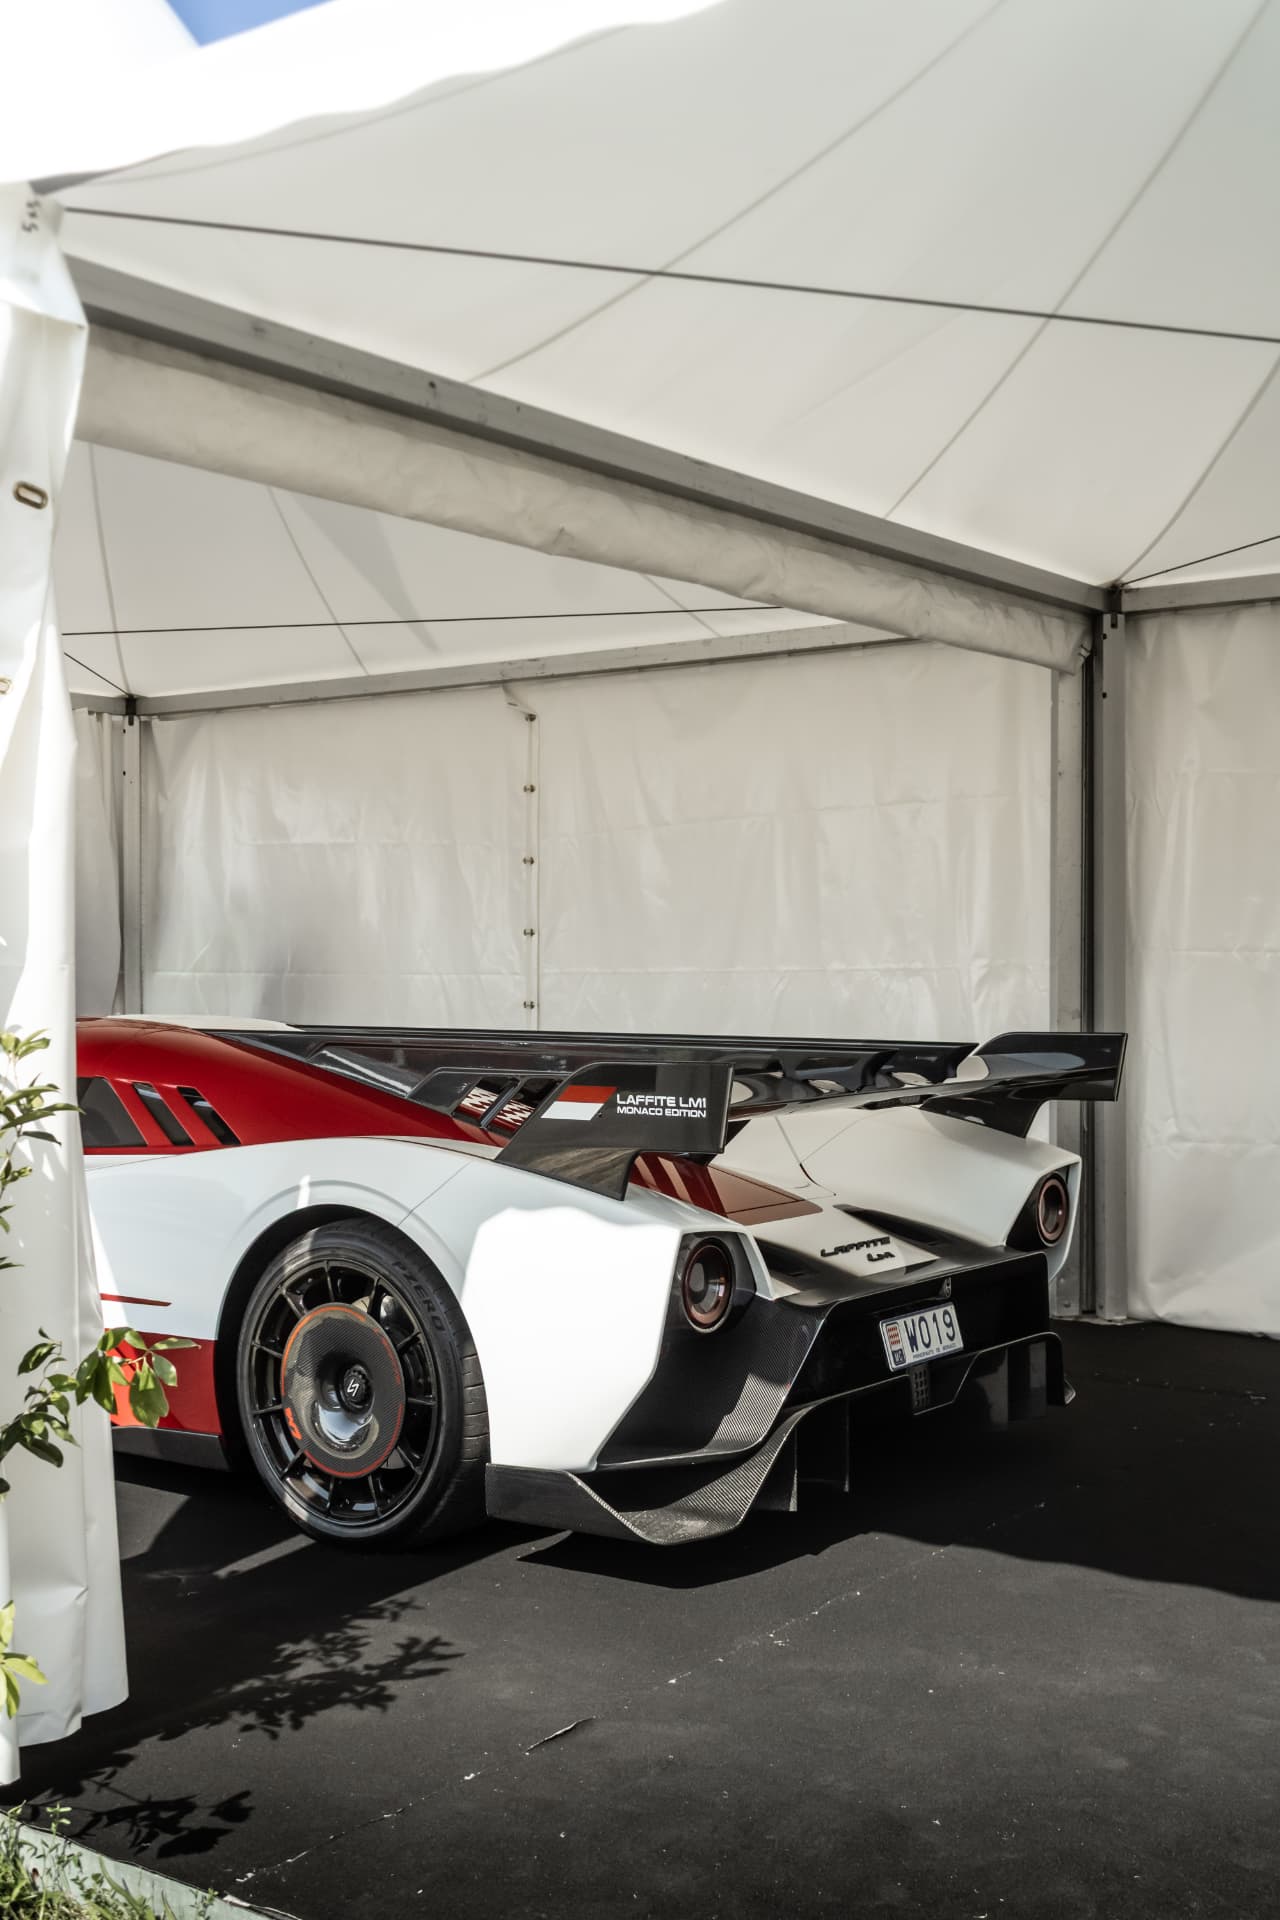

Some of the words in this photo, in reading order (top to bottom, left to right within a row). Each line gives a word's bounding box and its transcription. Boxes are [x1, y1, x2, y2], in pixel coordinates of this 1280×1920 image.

[616, 1093, 677, 1108] LAFFITE
[616, 1105, 663, 1117] MONACO
[664, 1107, 707, 1119] EDITION
[904, 1309, 956, 1353] W019
